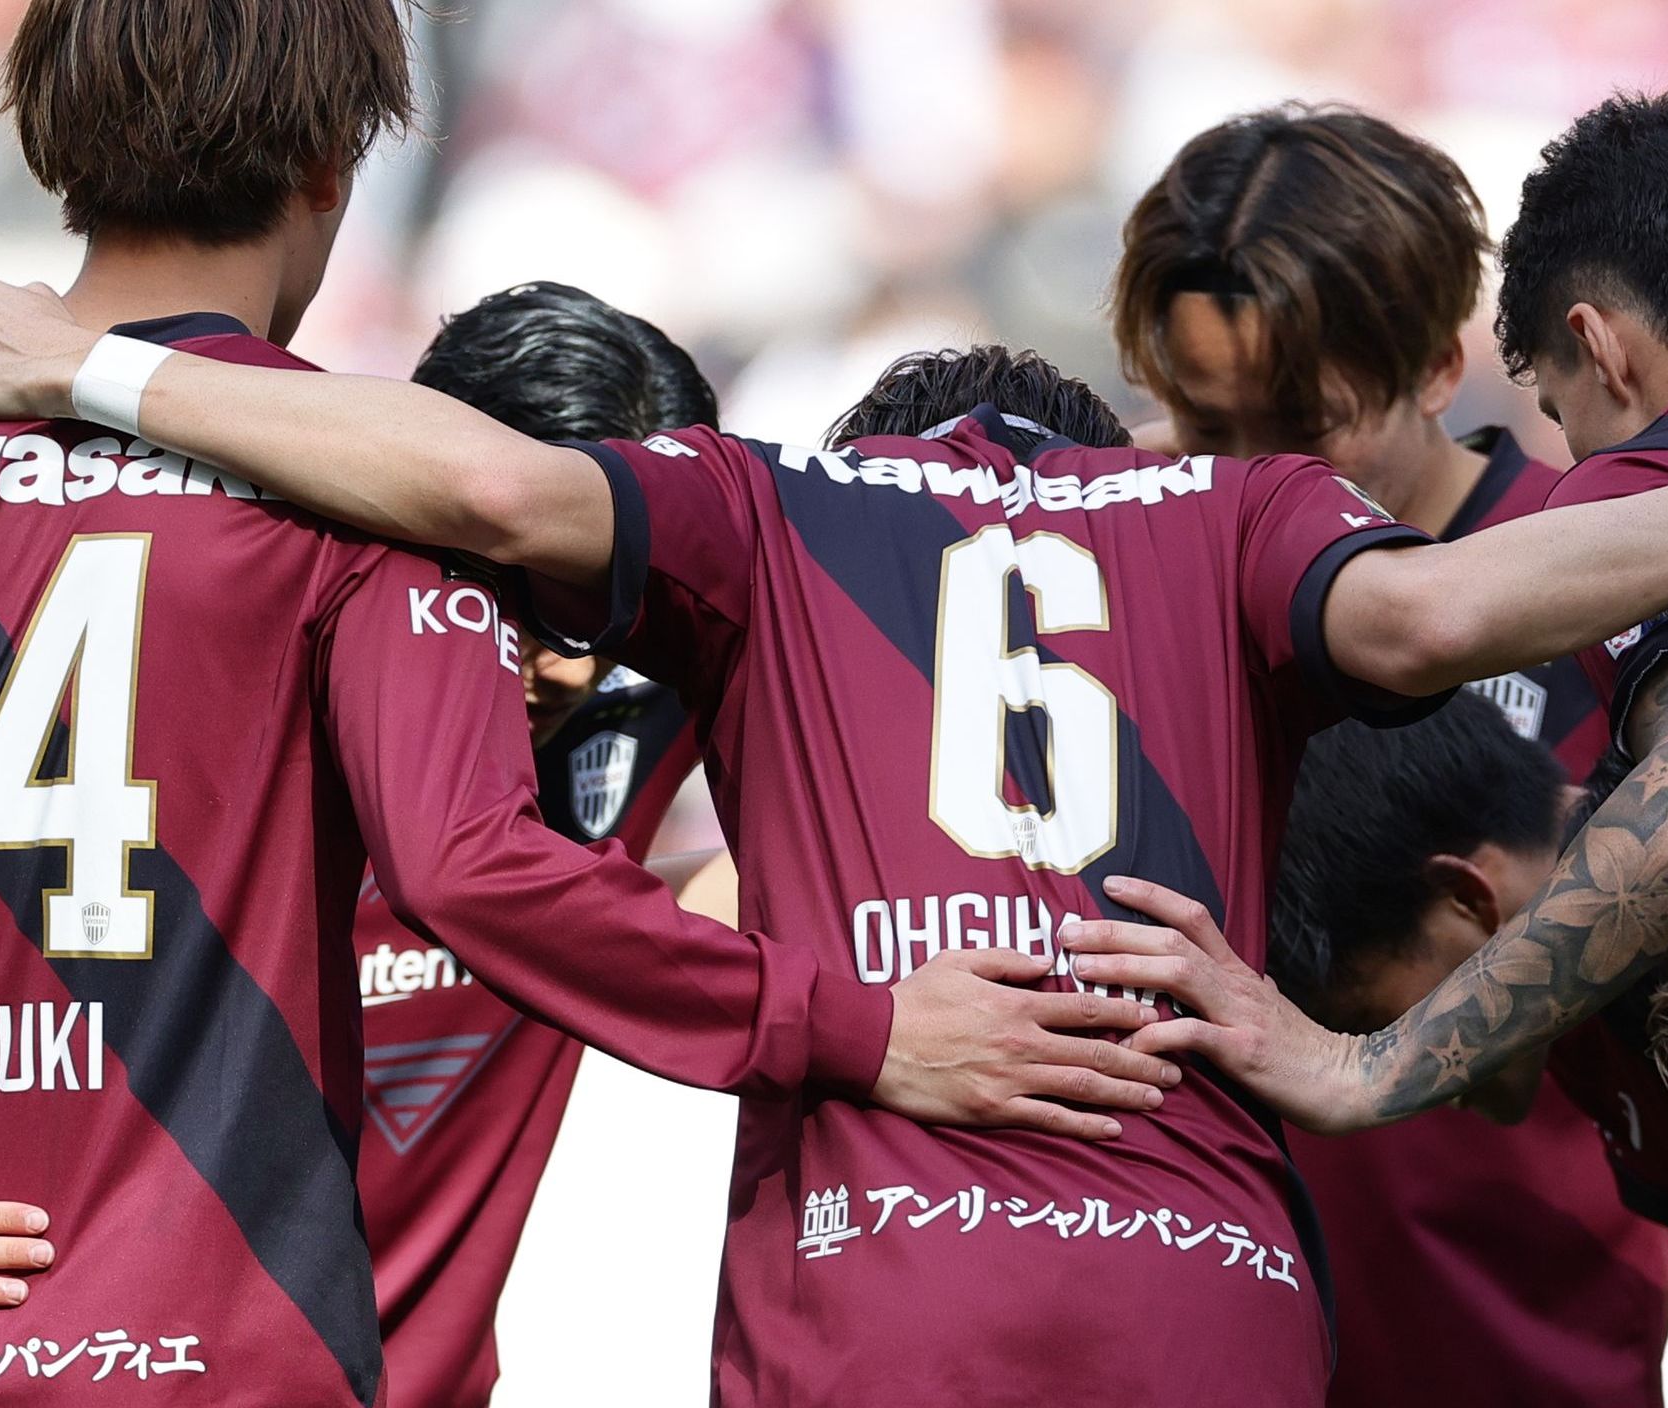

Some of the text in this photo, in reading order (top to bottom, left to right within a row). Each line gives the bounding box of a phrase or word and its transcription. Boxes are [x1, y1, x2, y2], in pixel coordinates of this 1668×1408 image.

[778, 444, 1214, 520] Kawasaki
[408, 586, 520, 676] KOE
[928, 523, 1120, 876] 6
